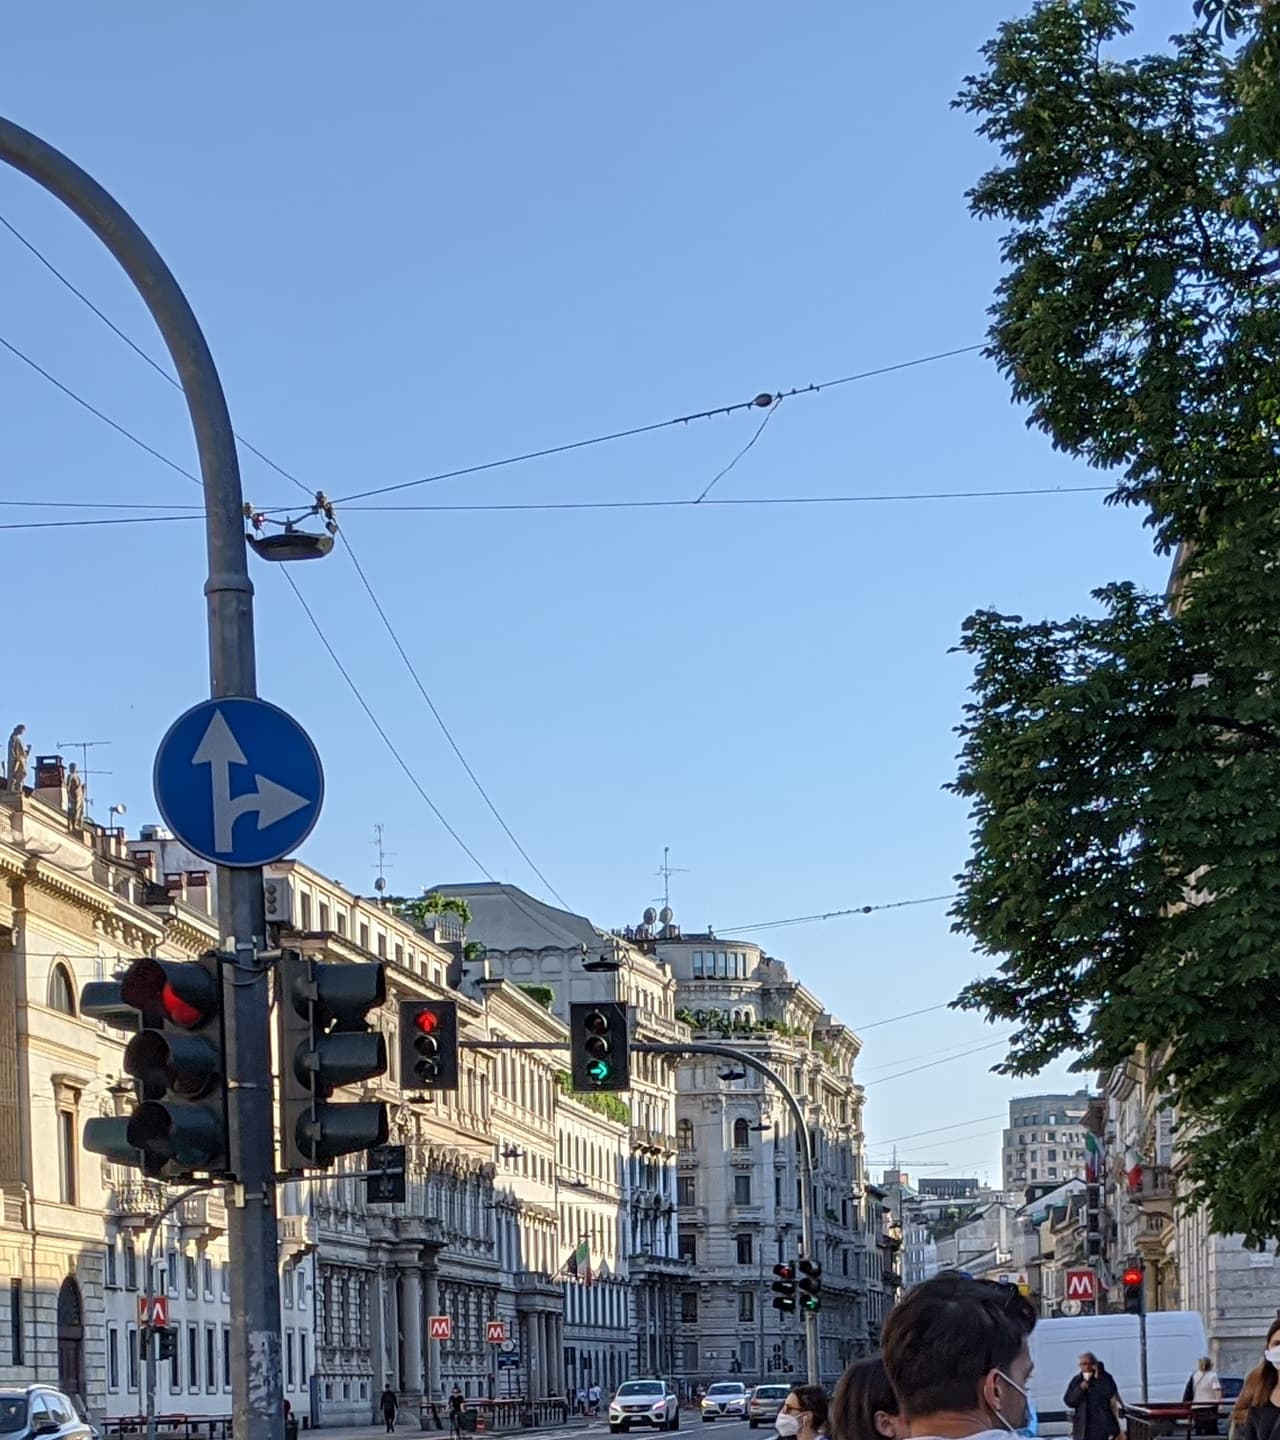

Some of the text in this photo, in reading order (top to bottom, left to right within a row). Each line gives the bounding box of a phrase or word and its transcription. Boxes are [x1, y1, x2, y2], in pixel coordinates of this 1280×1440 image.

[1068, 1275, 1093, 1295] M
[431, 1321, 450, 1336] M
[488, 1326, 504, 1339] M
